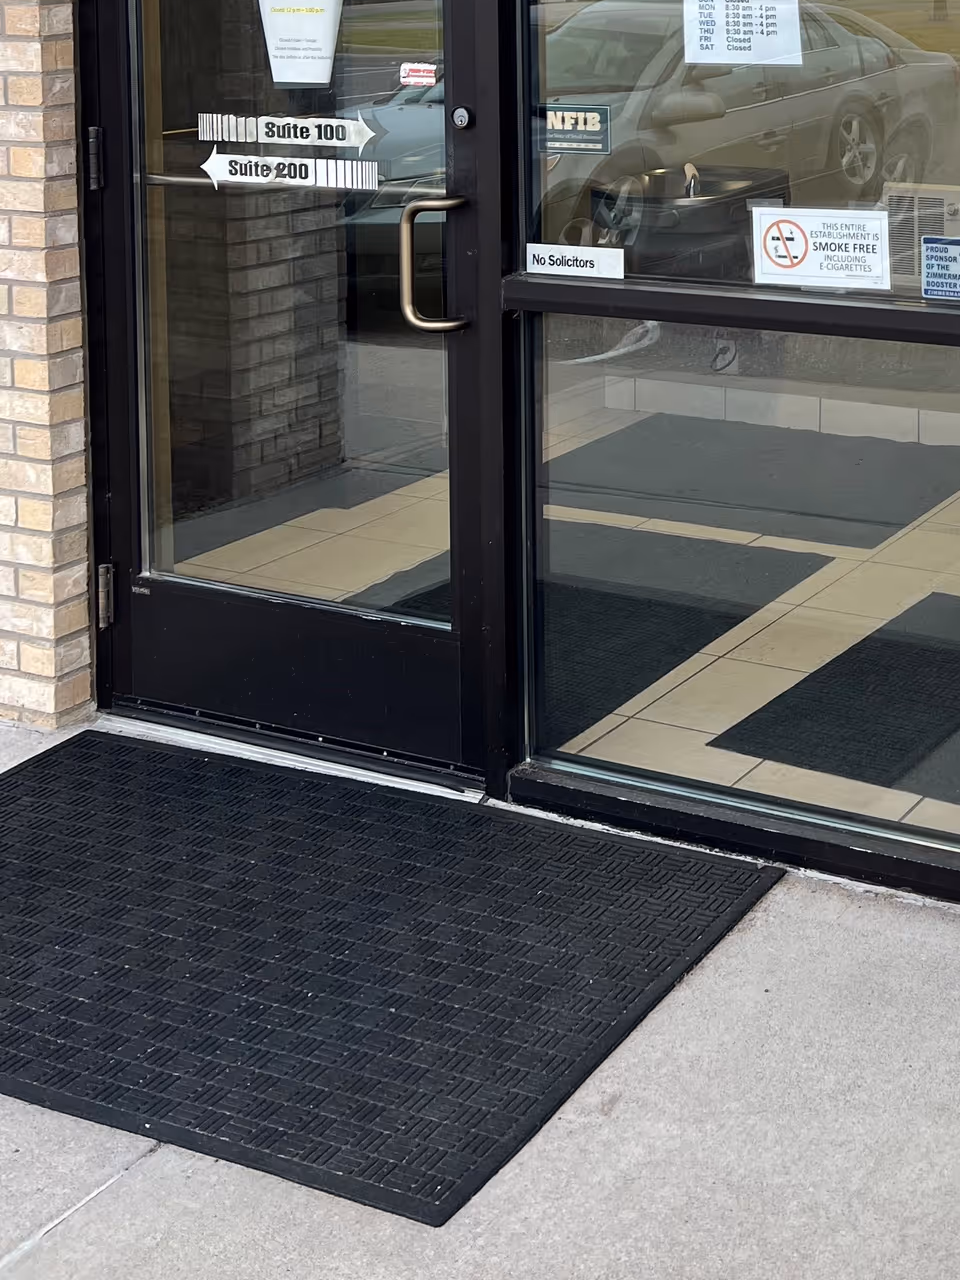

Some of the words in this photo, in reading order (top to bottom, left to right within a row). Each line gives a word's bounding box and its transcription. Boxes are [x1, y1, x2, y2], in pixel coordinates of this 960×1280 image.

[726, 36, 751, 44] Closed
[547, 111, 601, 131] NFIB
[264, 122, 310, 140] Suite
[315, 124, 346, 141] 100
[228, 160, 271, 178] Suite
[274, 162, 309, 180] 200
[822, 223, 838, 231] THIS
[841, 223, 866, 232] ENTIRE
[810, 231, 870, 240] ESTABLISHMENT
[872, 233, 880, 241] IS
[812, 242, 850, 253] SMOKE
[853, 243, 877, 254] FREE
[532, 253, 546, 266] No
[548, 255, 595, 269] Solicitors
[824, 255, 866, 264] INCLUDING
[925, 255, 958, 263] SPONSOR
[819, 263, 872, 273] E-CIGARETTES
[926, 281, 958, 289] BOOSTER
